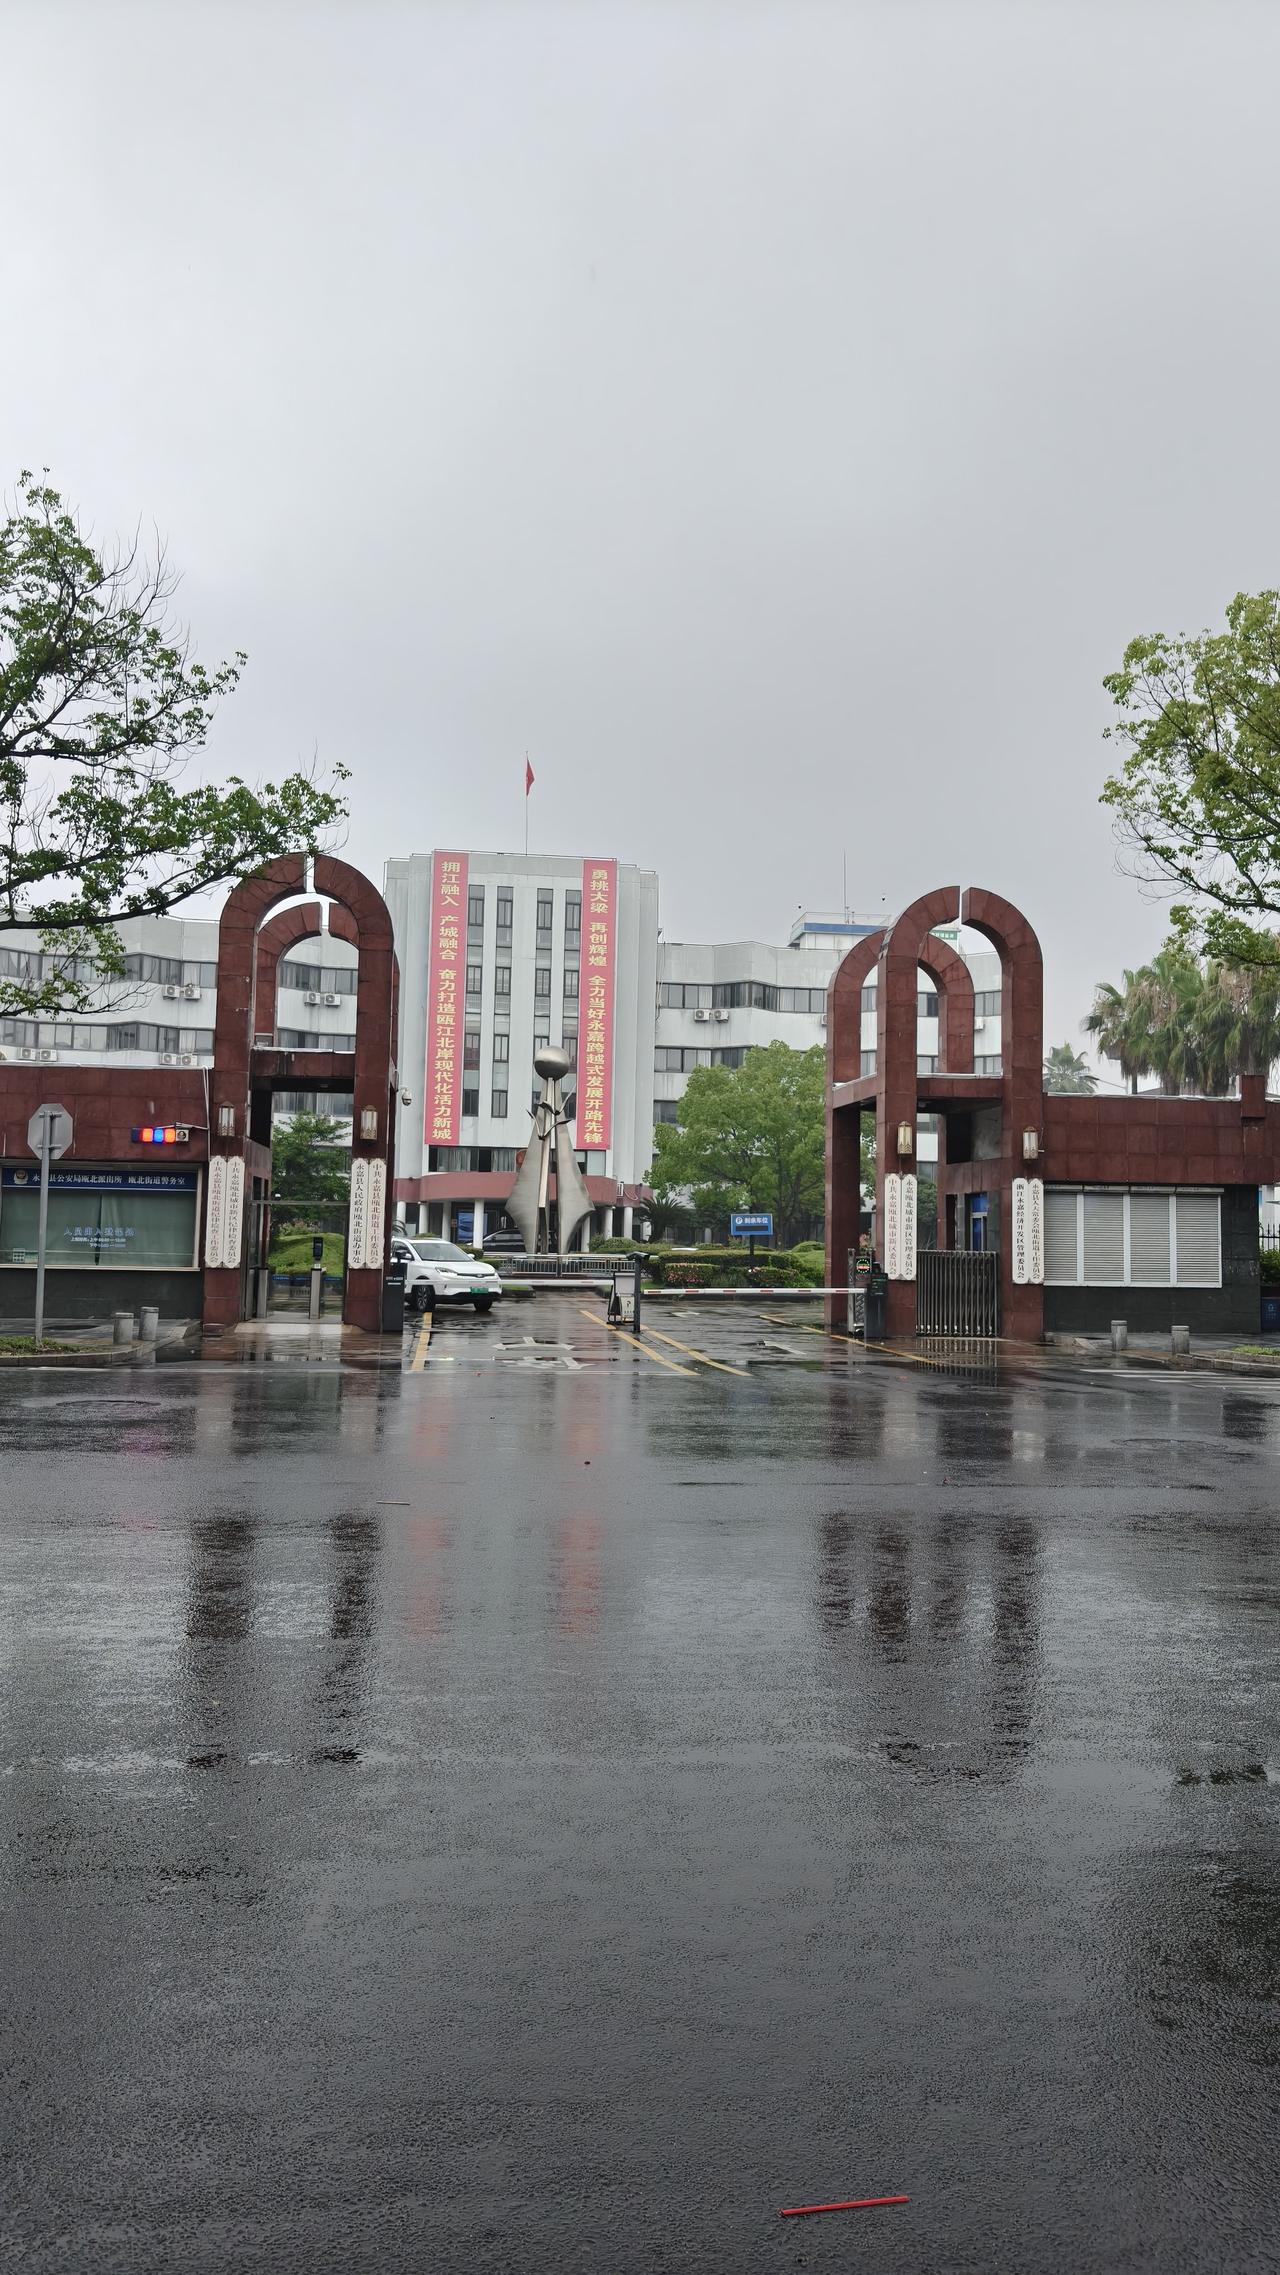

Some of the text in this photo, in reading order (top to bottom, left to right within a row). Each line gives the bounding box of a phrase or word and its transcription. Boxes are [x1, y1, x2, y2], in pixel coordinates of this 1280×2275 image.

[432, 861, 461, 1140] 拥江融入 产城融合 奋力打造瓯江北岸现代化活力新城
[583, 869, 609, 1144] 勇挑大梁 再创辉煌 全力当好永嘉跨越式发展开路先锋
[32, 1174, 123, 1185] 永县公安局瓯北派出所
